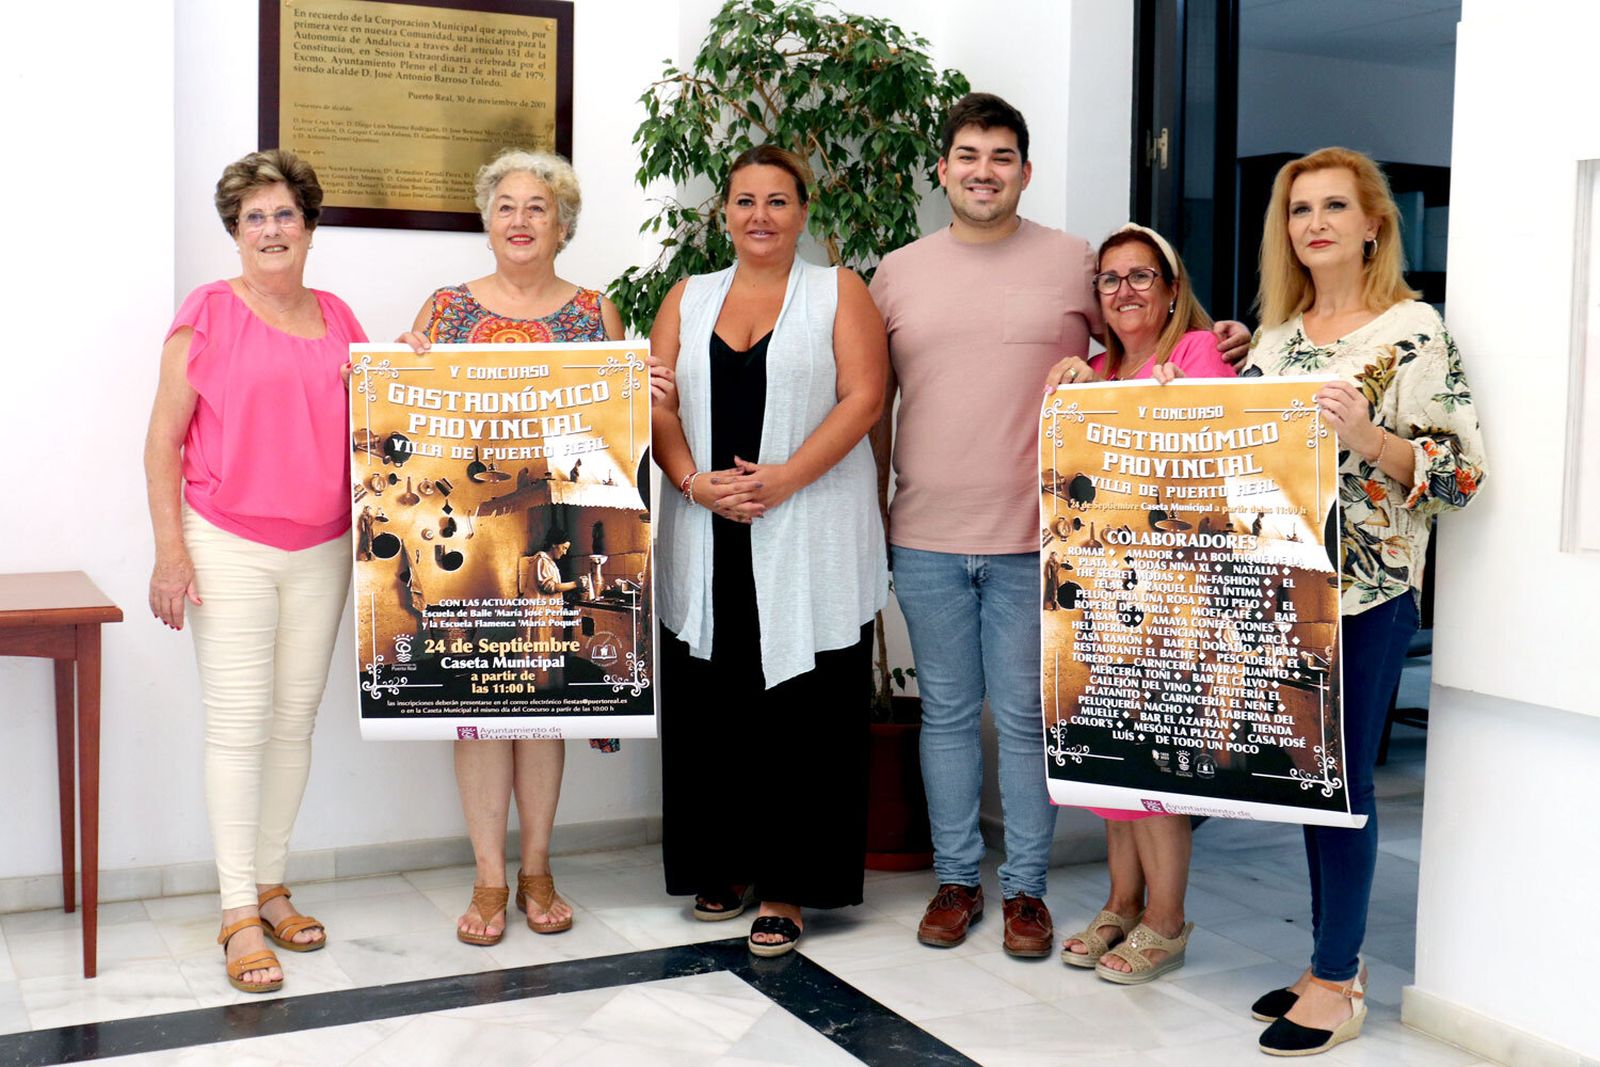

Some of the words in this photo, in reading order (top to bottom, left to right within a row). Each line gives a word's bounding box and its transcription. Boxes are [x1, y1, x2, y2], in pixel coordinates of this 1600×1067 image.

[294, 8, 306, 18] En
[308, 9, 349, 21] recuerdo
[350, 13, 362, 22] de
[364, 14, 372, 23] la
[432, 20, 478, 34] Municipal
[479, 26, 496, 36] que
[532, 31, 546, 40] por
[294, 20, 330, 32] primera
[364, 25, 398, 36] nuestra
[476, 34, 516, 46] iniciativa
[518, 40, 536, 50] para
[538, 40, 546, 49] la
[293, 62, 324, 73] siendo
[326, 65, 359, 76] alcalde
[396, 70, 432, 82] Antonio
[434, 74, 468, 85] Barroso
[331, 55, 396, 70] Ayuntamiento
[400, 60, 425, 71] Pleno
[429, 63, 437, 72] el
[458, 65, 468, 74] 21
[472, 66, 482, 75] de
[486, 67, 507, 77] abril
[511, 69, 521, 78] de
[448, 366, 460, 378] V
[467, 364, 549, 380] CONCURSO
[388, 380, 610, 413] GASTRONÓMICO
[1138, 407, 1148, 418] V
[1152, 405, 1224, 420] CONCURSO
[408, 412, 592, 440] PROVINCIAL
[1086, 422, 1280, 452] GASTRONÓMICO
[392, 438, 443, 457] VILLA
[451, 447, 474, 460] DE
[483, 445, 554, 460] PUERTO
[562, 436, 610, 456] REAL
[1102, 452, 1263, 479] PROVINCIAL
[1089, 475, 1132, 495] VILLA
[1139, 484, 1158, 497] DE
[1166, 484, 1228, 499] PUERTO
[1236, 479, 1280, 495] REAL
[1170, 504, 1212, 513] Municipal
[1107, 530, 1258, 550] COLABORADORES
[1068, 547, 1105, 556] ROMAR
[1126, 550, 1173, 559] AMADOR
[1195, 552, 1205, 561] LA
[1199, 563, 1211, 572] XL
[1233, 565, 1278, 576] NATALIA
[1189, 584, 1219, 595] LÍNEA
[1283, 578, 1295, 588] EL
[482, 598, 546, 606] ACTUACIONES
[525, 608, 543, 617] José
[1119, 602, 1132, 611] DE
[1134, 603, 1169, 614] MARÍA
[1191, 608, 1222, 617] MOET
[1225, 608, 1252, 619] CAFÉ
[1275, 612, 1297, 622] BAR
[1166, 594, 1194, 605] ROSA
[1198, 597, 1211, 606] PA
[1214, 597, 1228, 606] TU
[1232, 598, 1259, 608] PELO
[1283, 601, 1295, 610] EL
[1083, 611, 1131, 622] TABANCO
[1152, 616, 1188, 626] AMAYA
[1191, 618, 1274, 632] CONFECCIONES
[1075, 632, 1100, 642] CASA
[1103, 633, 1142, 645] RAMÓN
[1163, 638, 1185, 648] BAR
[1188, 640, 1200, 650] EL
[1203, 642, 1252, 653] DORADO
[1275, 647, 1297, 656] BAR
[1146, 626, 1210, 639] VALENCIANA
[1233, 632, 1255, 642] BAR
[1258, 634, 1288, 644] ARCA
[425, 640, 446, 653] 24
[451, 639, 473, 653] de
[478, 638, 580, 657] Septiembre
[1073, 642, 1143, 655] RESTAURANTE
[1146, 648, 1156, 656] EL
[1160, 648, 1194, 660] BACHE
[1217, 653, 1284, 667] PESCADERÍA
[1288, 658, 1300, 668] EL
[441, 657, 489, 669] Caseta
[492, 656, 565, 672] Municipal
[1072, 653, 1113, 663] TORERO
[1134, 658, 1197, 671] CARNICERÍA
[482, 671, 517, 684] partir
[520, 671, 535, 681] de
[1090, 665, 1142, 677] MERCERÍA
[1145, 669, 1170, 680] TOÑI
[1192, 674, 1214, 684] BAR
[1218, 676, 1228, 684] EL
[1233, 677, 1267, 688] CALVO
[472, 684, 489, 694] las
[493, 684, 524, 693] 11:00
[527, 684, 535, 693] h
[1090, 675, 1139, 689] CALLEJÓN
[1142, 680, 1160, 690] DEL
[1164, 682, 1191, 692] VINO
[1213, 687, 1265, 699] FRUTERÍA
[1269, 691, 1281, 700] EL
[1085, 686, 1140, 698] PLATANITO
[1161, 693, 1226, 707] CARNICERÍA
[1230, 699, 1241, 708] EL
[1245, 701, 1274, 712] NENE
[1078, 695, 1141, 710] PELUQUERÍA
[1144, 702, 1182, 714] NACHO
[1205, 708, 1217, 717] LA
[1220, 709, 1270, 722] TABERNA
[1274, 715, 1295, 725] DEL
[1081, 706, 1119, 718] MUELLE
[1140, 713, 1160, 722] BAR
[1164, 714, 1176, 724] EL
[1178, 715, 1228, 729] AZAFRÁN
[1251, 723, 1293, 735] TIENDA
[480, 727, 547, 736] Ayuntamiento
[1112, 730, 1134, 741] LUÍS
[1156, 735, 1170, 745] DE
[1172, 736, 1203, 748] TODO
[1207, 740, 1223, 750] UN
[1226, 742, 1259, 754] POCO
[1134, 721, 1171, 735] MESÓN
[1174, 726, 1187, 736] LA
[1190, 728, 1225, 739] PLAZA
[1247, 734, 1276, 745] CASA
[1279, 737, 1306, 748] JOSÉ
